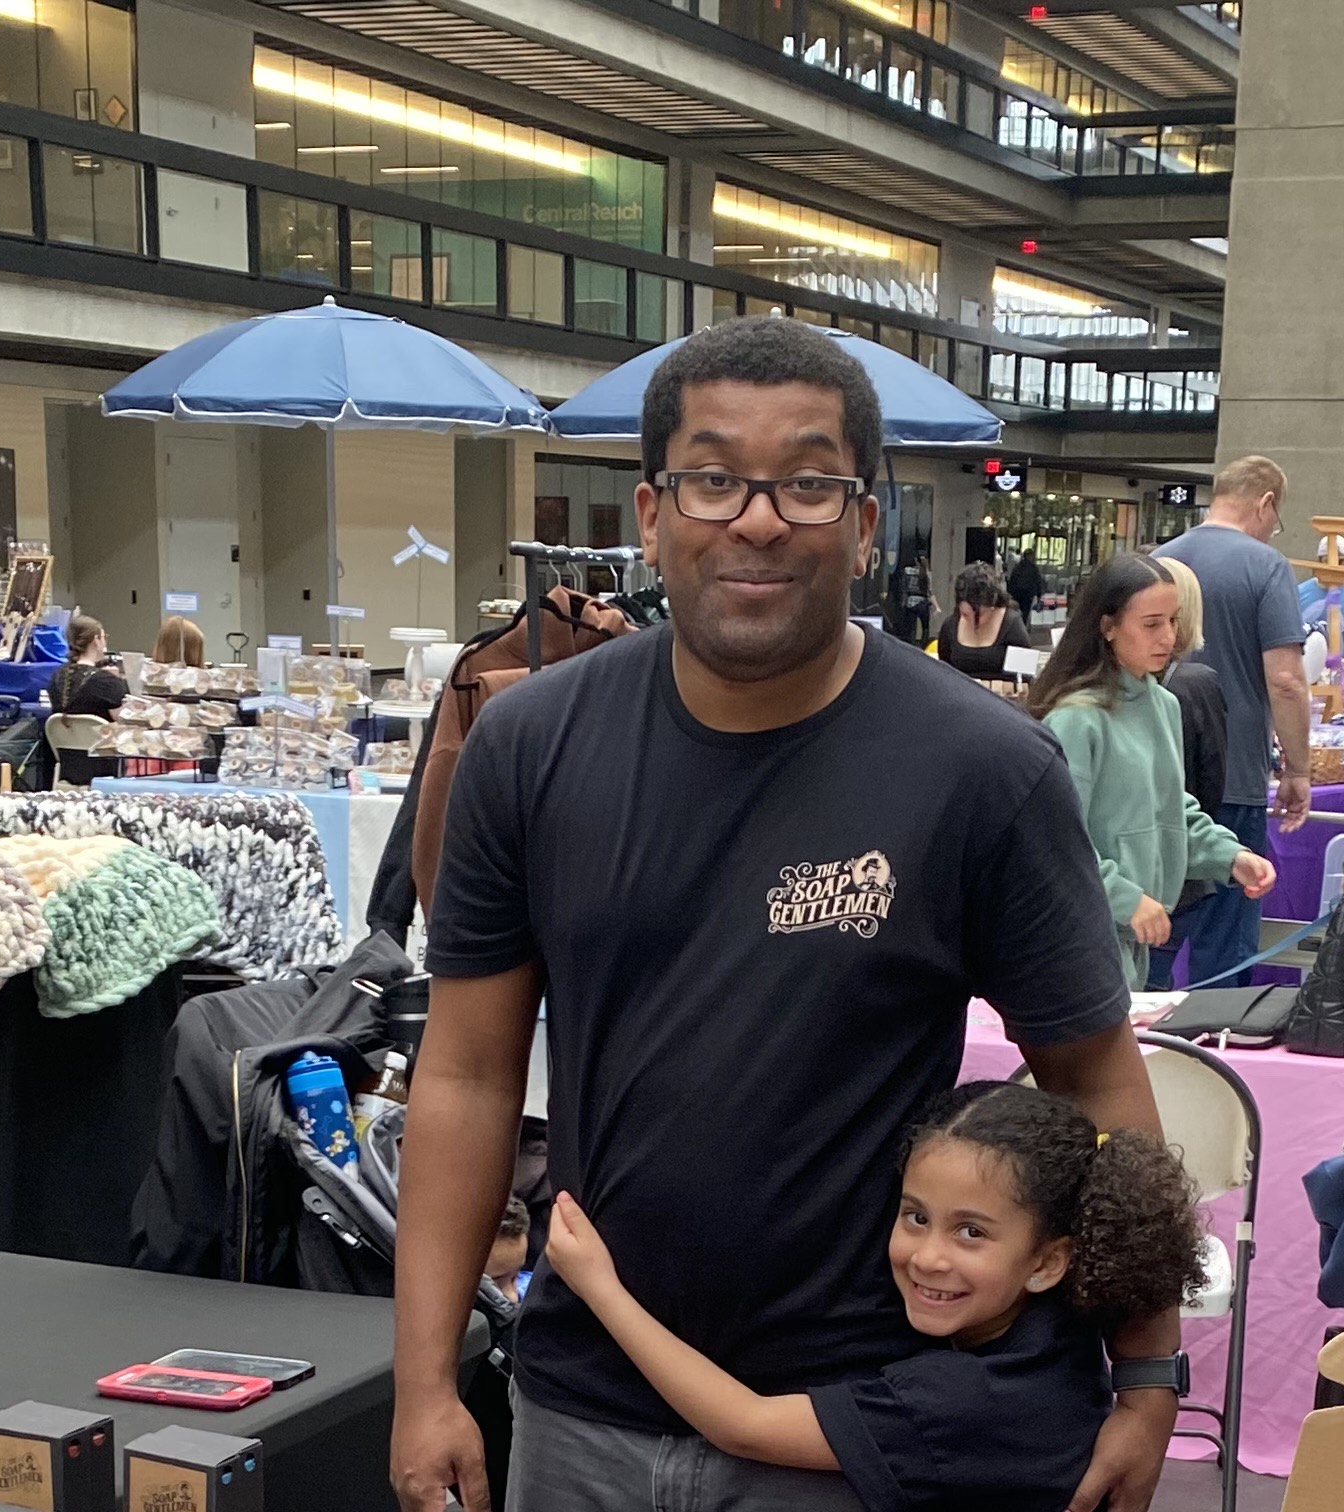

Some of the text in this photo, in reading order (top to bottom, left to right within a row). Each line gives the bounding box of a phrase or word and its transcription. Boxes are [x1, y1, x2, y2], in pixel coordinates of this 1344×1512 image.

[522, 202, 644, 224] CentralReach
[815, 861, 842, 878] THE
[791, 874, 852, 902] SOAP
[769, 893, 892, 925] GENTLEMEN
